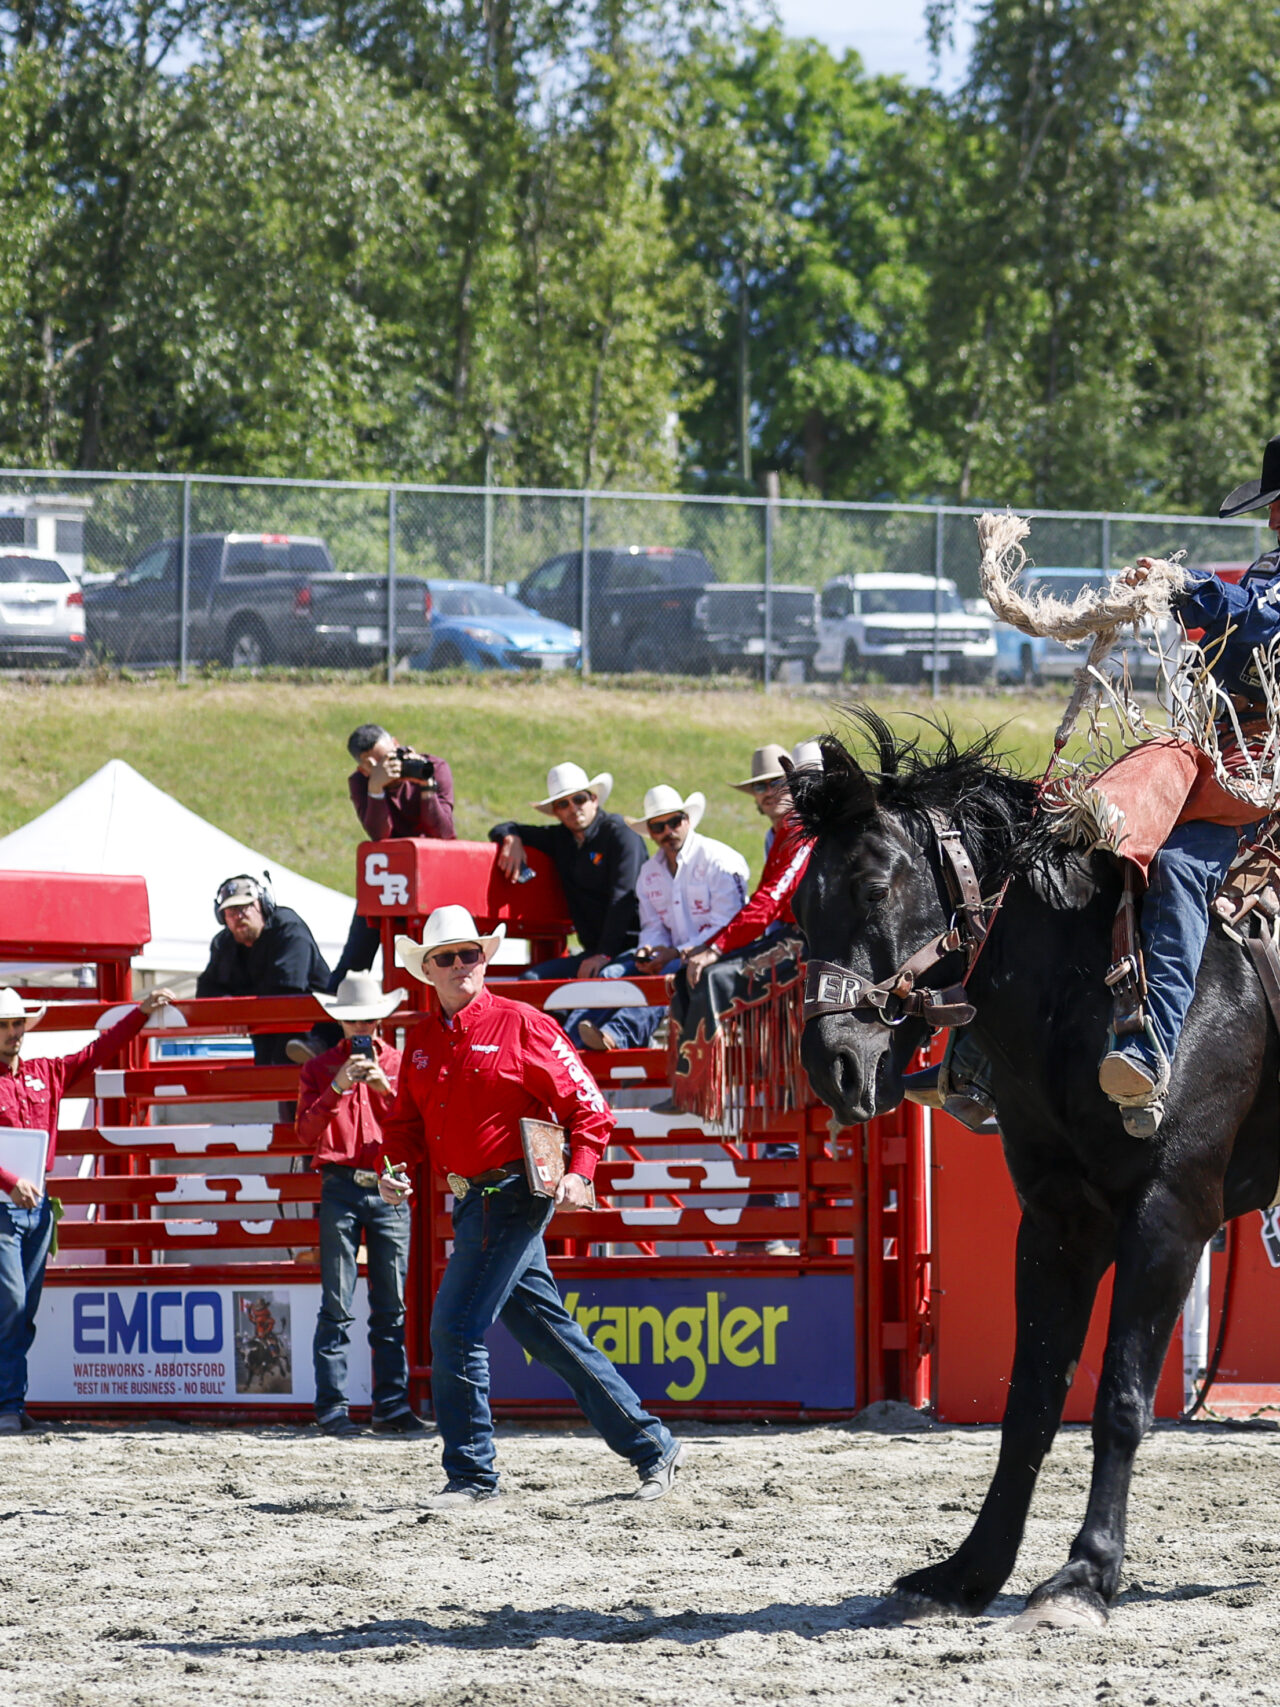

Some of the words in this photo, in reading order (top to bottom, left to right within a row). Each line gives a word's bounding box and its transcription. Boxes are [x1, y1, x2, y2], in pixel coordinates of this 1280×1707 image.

[365, 853, 410, 906] CR
[551, 1035, 604, 1113] Wrangle
[73, 1291, 224, 1354] EMCO
[522, 1291, 789, 1401] rangler
[73, 1363, 145, 1378] WATERWORKS
[154, 1362, 226, 1378] ABBOTSFORD
[73, 1381, 99, 1394] "BEST
[101, 1382, 110, 1394] IN
[112, 1382, 128, 1394] THE
[130, 1382, 176, 1394] BUSINESS
[184, 1382, 198, 1394] NO
[200, 1381, 226, 1394] BULL"
